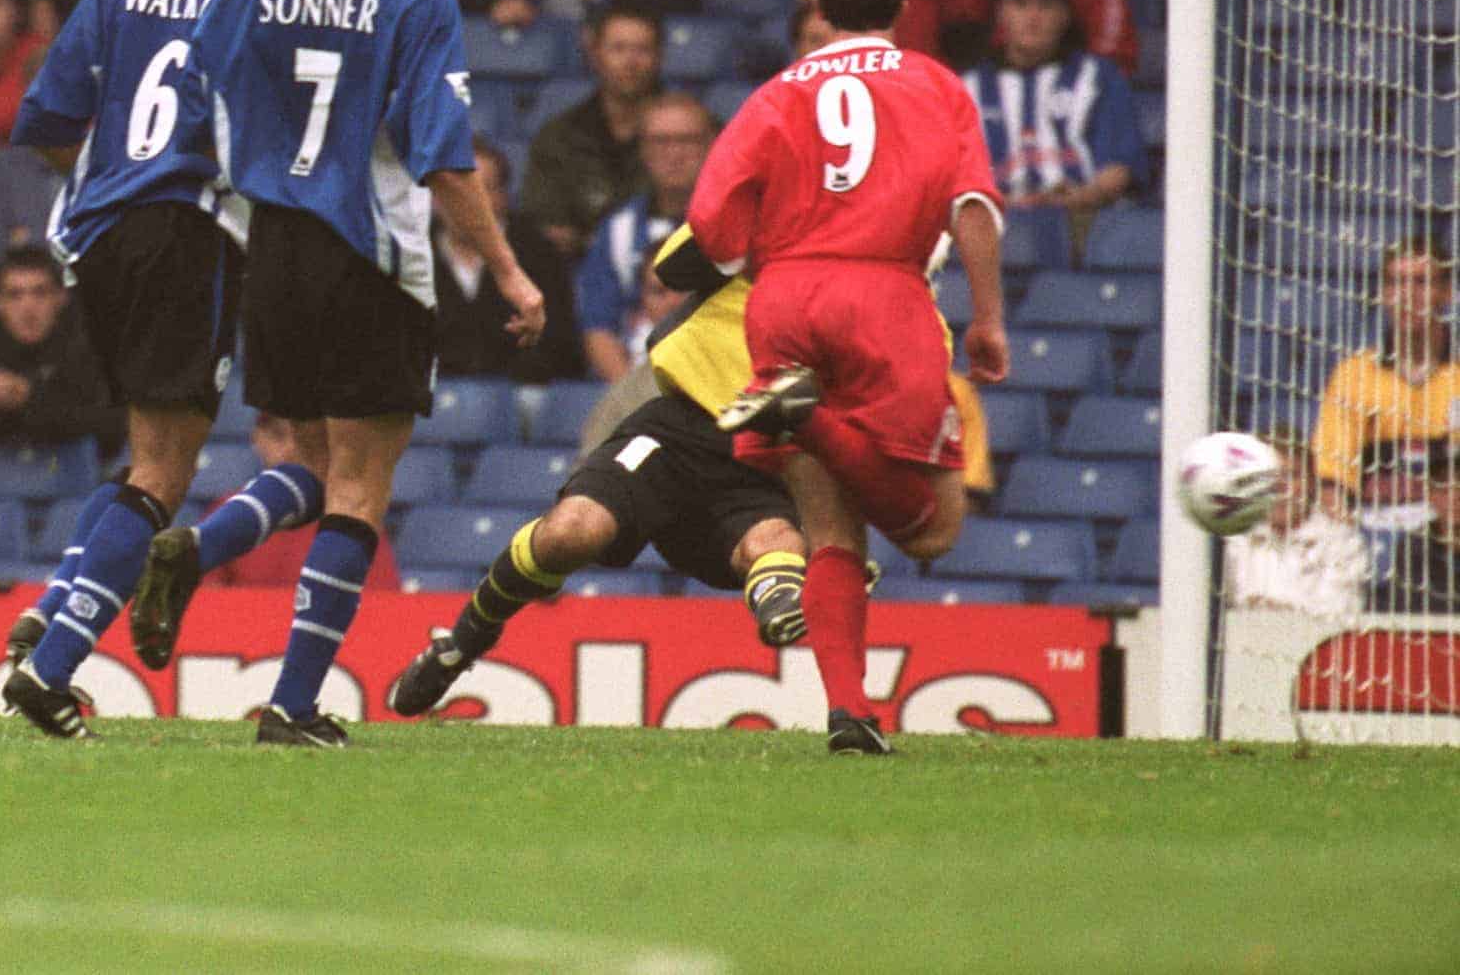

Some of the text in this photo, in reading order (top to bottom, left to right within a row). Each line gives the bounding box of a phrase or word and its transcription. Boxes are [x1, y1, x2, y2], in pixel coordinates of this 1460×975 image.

[127, 39, 190, 161] 6
[290, 48, 343, 176] 7
[816, 75, 876, 192] 9
[1044, 648, 1085, 672] TM
